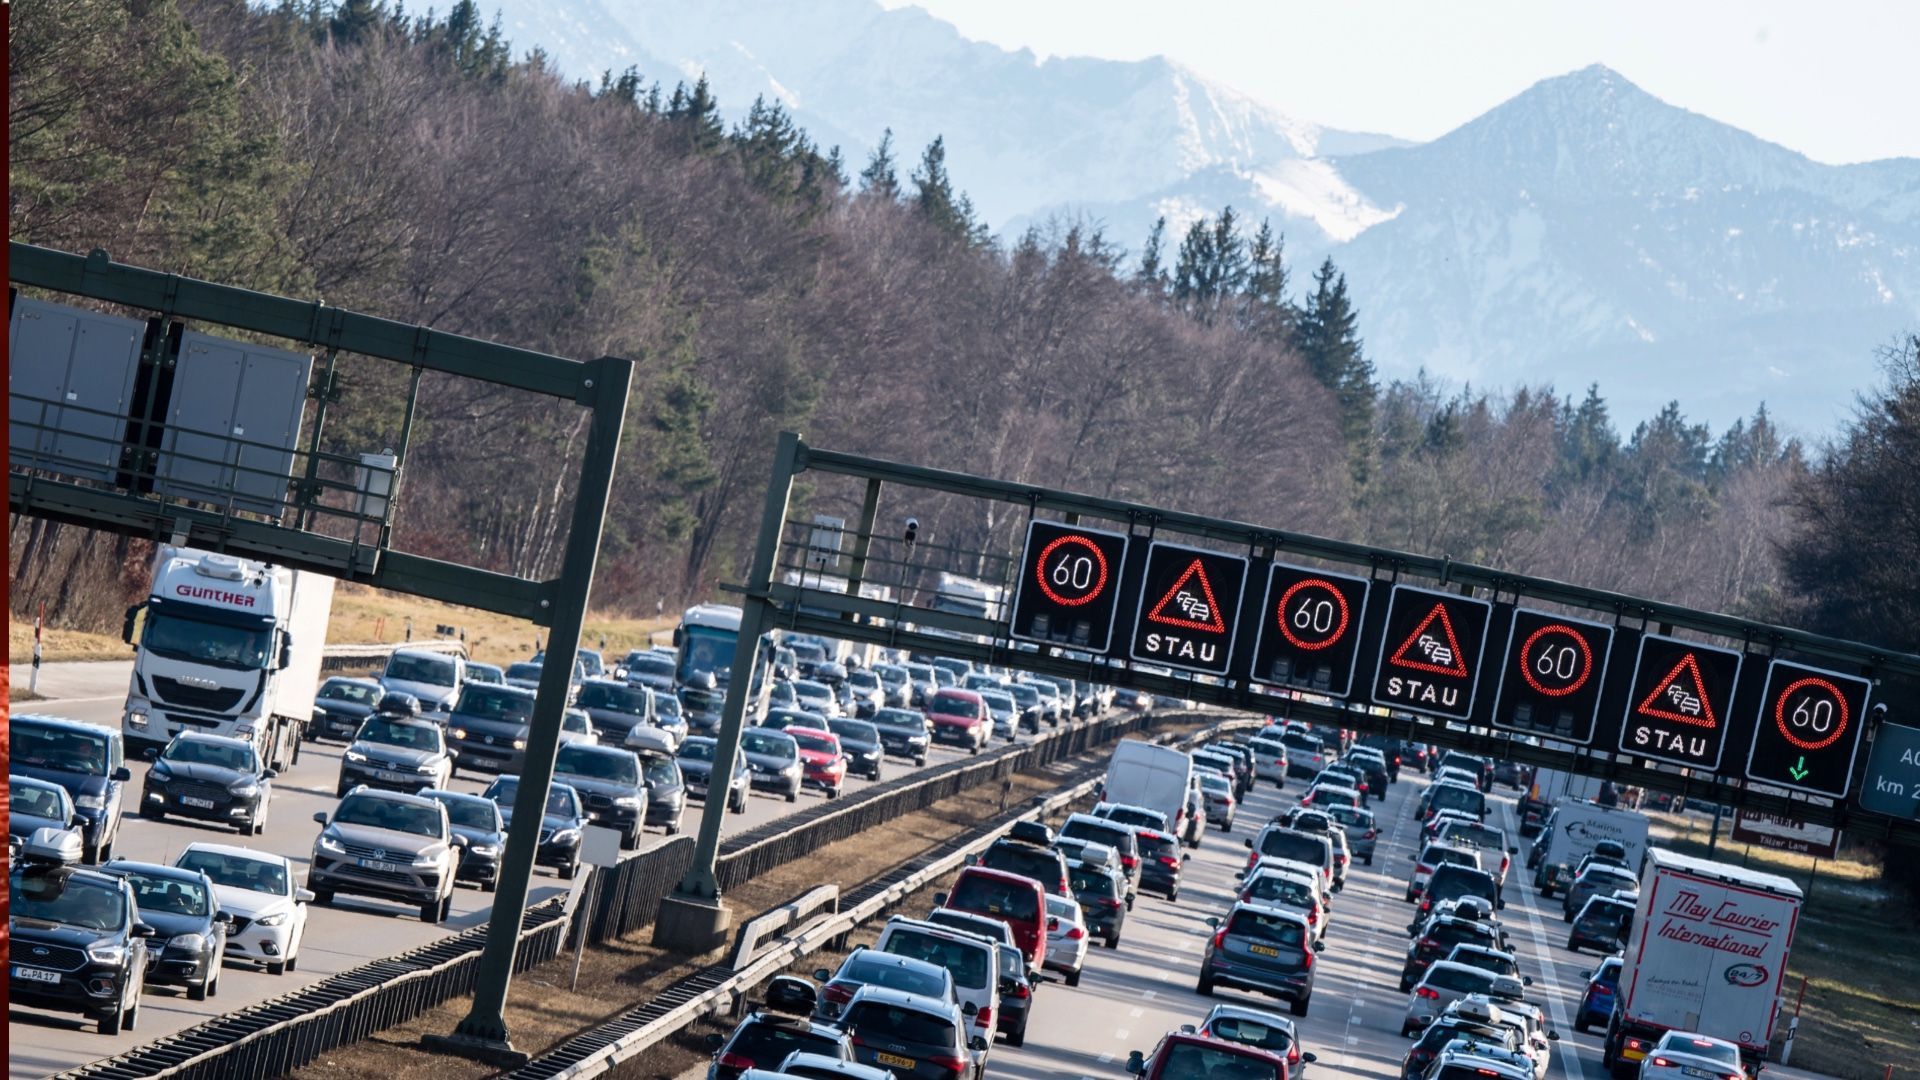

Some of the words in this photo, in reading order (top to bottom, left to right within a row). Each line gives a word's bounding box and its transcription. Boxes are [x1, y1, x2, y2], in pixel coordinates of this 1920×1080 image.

[1053, 554, 1092, 590] 60
[1294, 597, 1334, 634] 60
[1145, 633, 1217, 663] STAU
[1537, 643, 1577, 680] 60
[1387, 676, 1459, 708] STAU
[1792, 696, 1833, 733] 60
[1634, 726, 1707, 757] STAU
[1876, 775, 1904, 796] km
[1788, 840, 1808, 852] Land
[1669, 891, 1712, 921] May
[1712, 902, 1779, 931] Courier
[1657, 919, 1769, 959] International
[1730, 969, 1763, 981] 24/7
